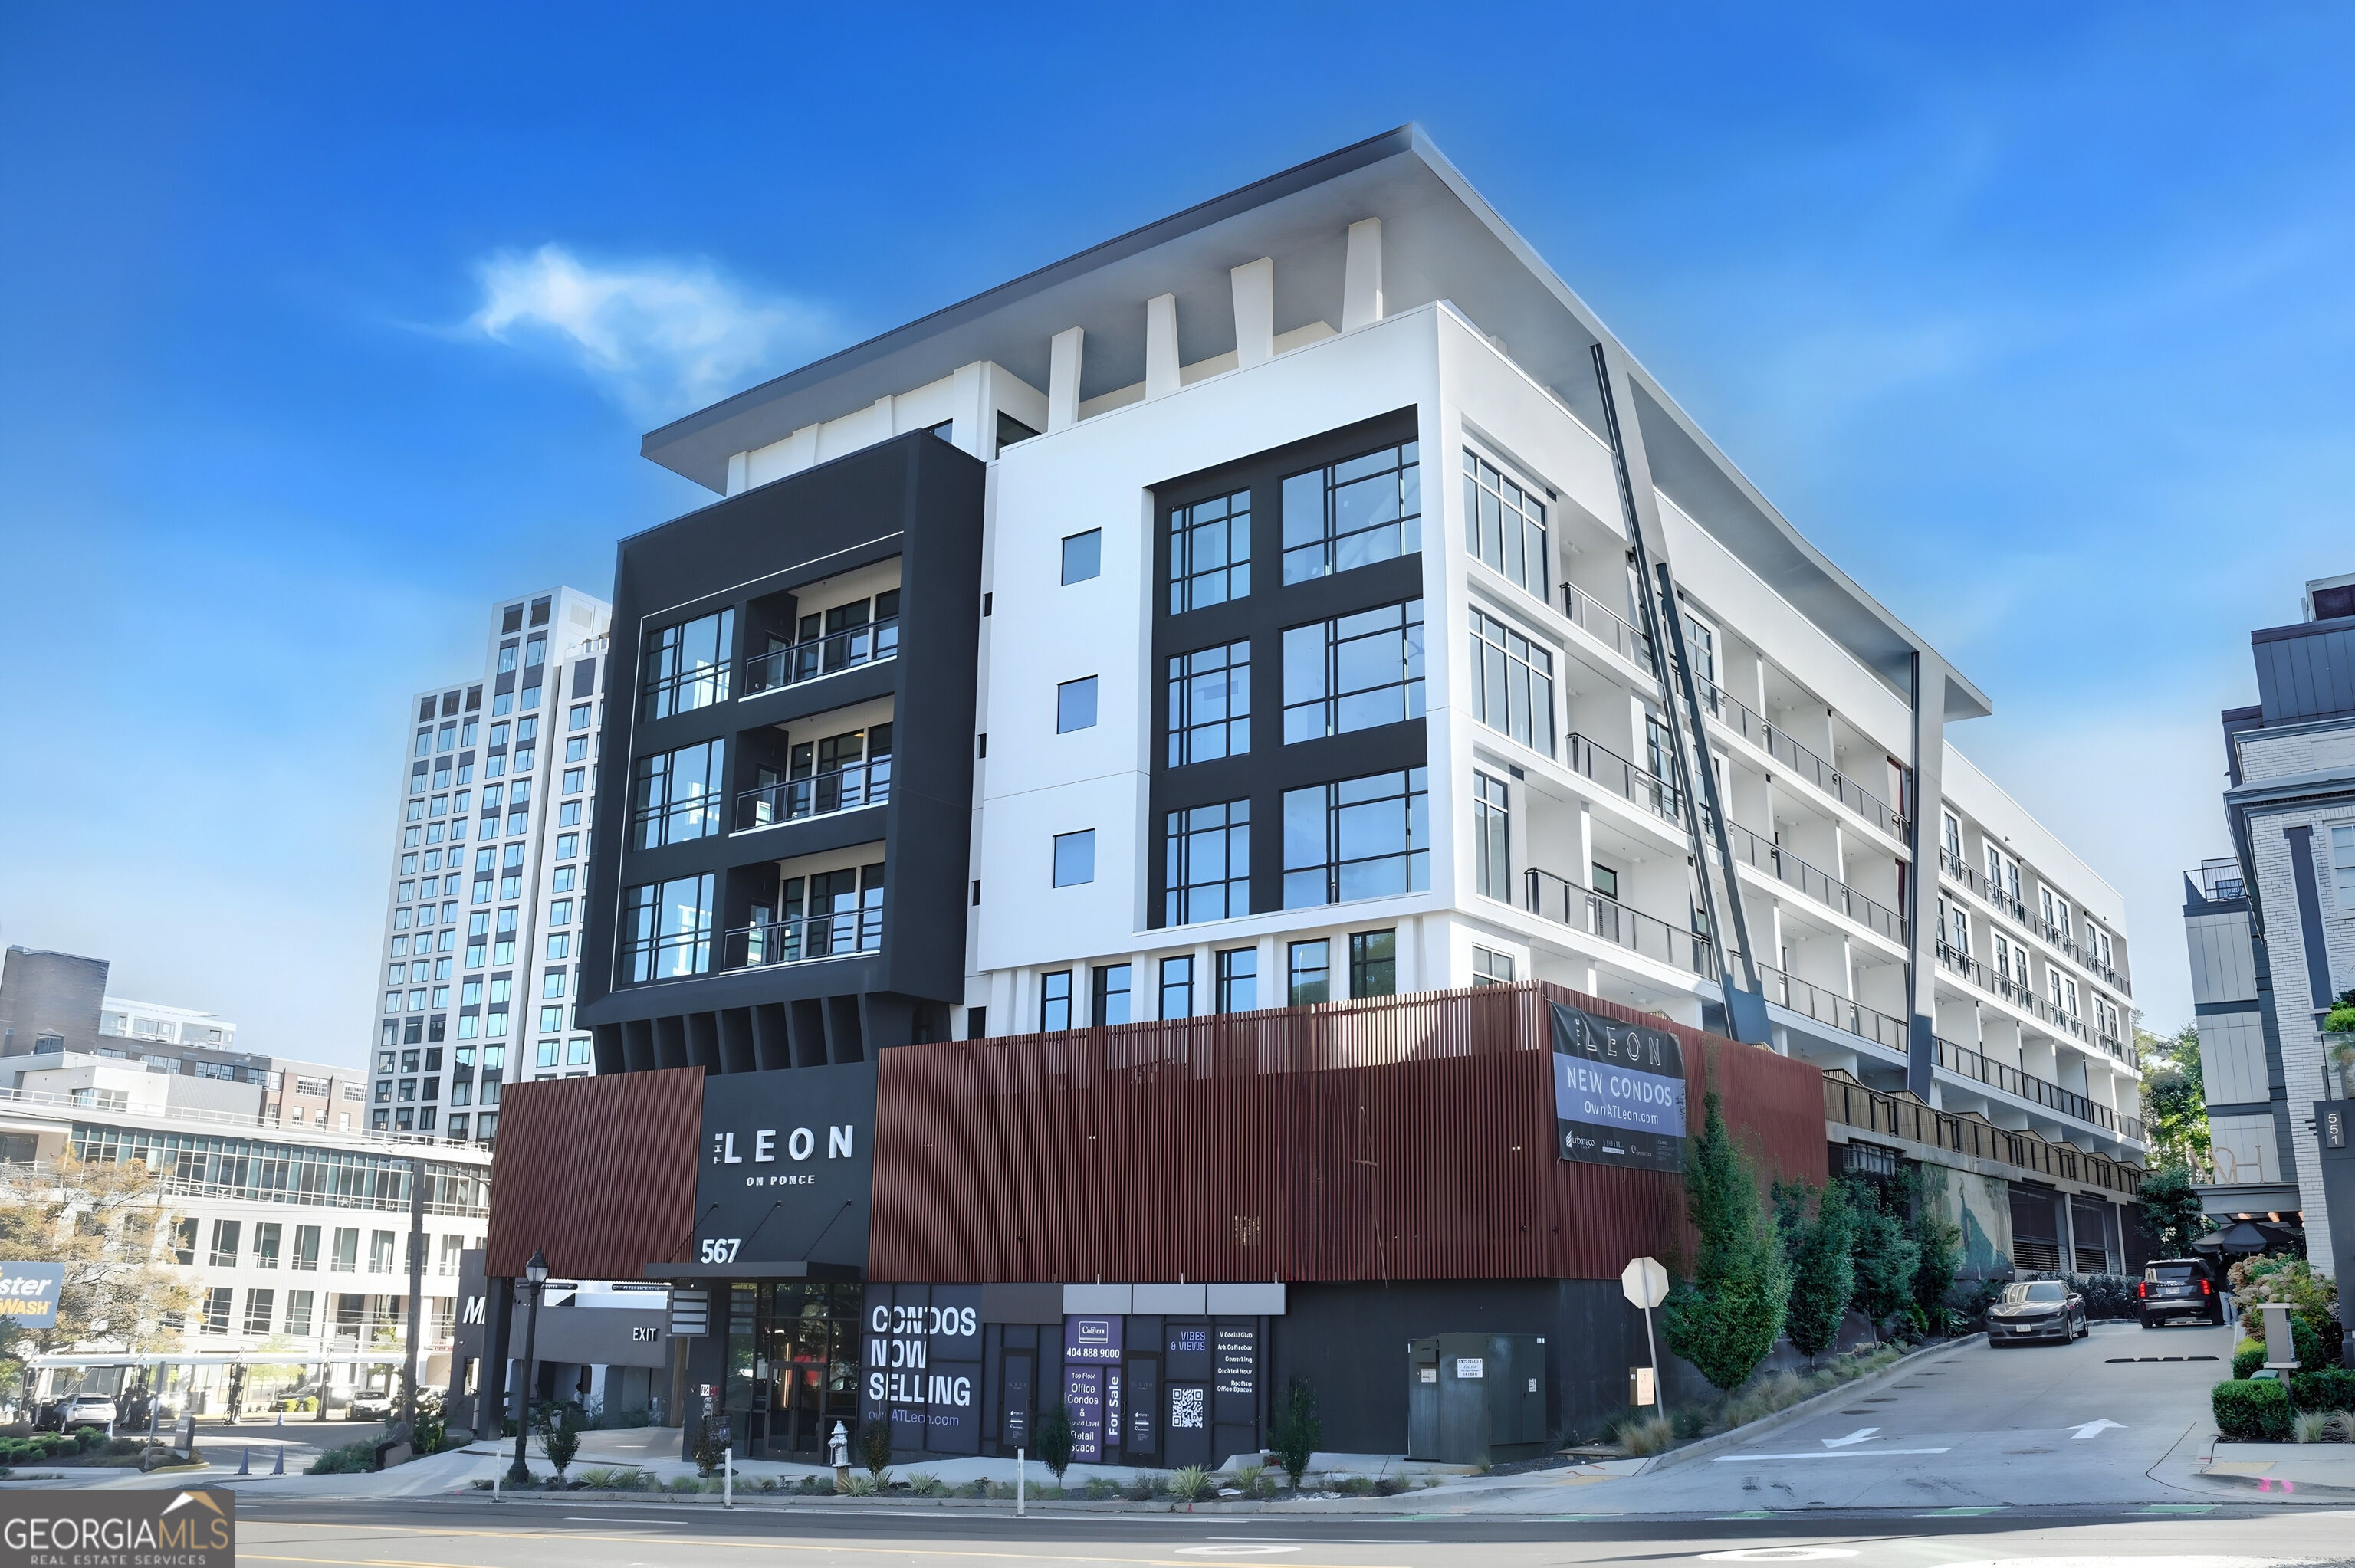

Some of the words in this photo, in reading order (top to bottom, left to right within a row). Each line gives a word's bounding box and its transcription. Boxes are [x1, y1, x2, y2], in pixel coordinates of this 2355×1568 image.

[1585, 1022, 1660, 1066] LEON
[1567, 1066, 1603, 1094] NEW
[1611, 1076, 1672, 1107] CONDOS
[1585, 1101, 1659, 1124] OwnATLeon.com
[2328, 1113, 2339, 1145] 551
[724, 1125, 853, 1163] LEON
[747, 1177, 764, 1186] ON
[770, 1175, 815, 1186] PONCE
[701, 1238, 741, 1264] 567
[872, 1305, 976, 1337] CONDOS
[632, 1327, 657, 1342] EXIT
[1179, 1341, 1205, 1350] VIEWS
[1181, 1331, 1206, 1340] VIBES
[871, 1339, 927, 1368] NOW
[1066, 1347, 1081, 1357] 404
[1083, 1348, 1098, 1357] 888
[1100, 1349, 1120, 1358] 9000
[869, 1372, 971, 1406] SELLING
[1067, 1394, 1099, 1405] Condos
[1071, 1383, 1095, 1393] Office
[1109, 1376, 1119, 1407] Sale
[1079, 1408, 1085, 1417] &
[1109, 1411, 1118, 1435] For
